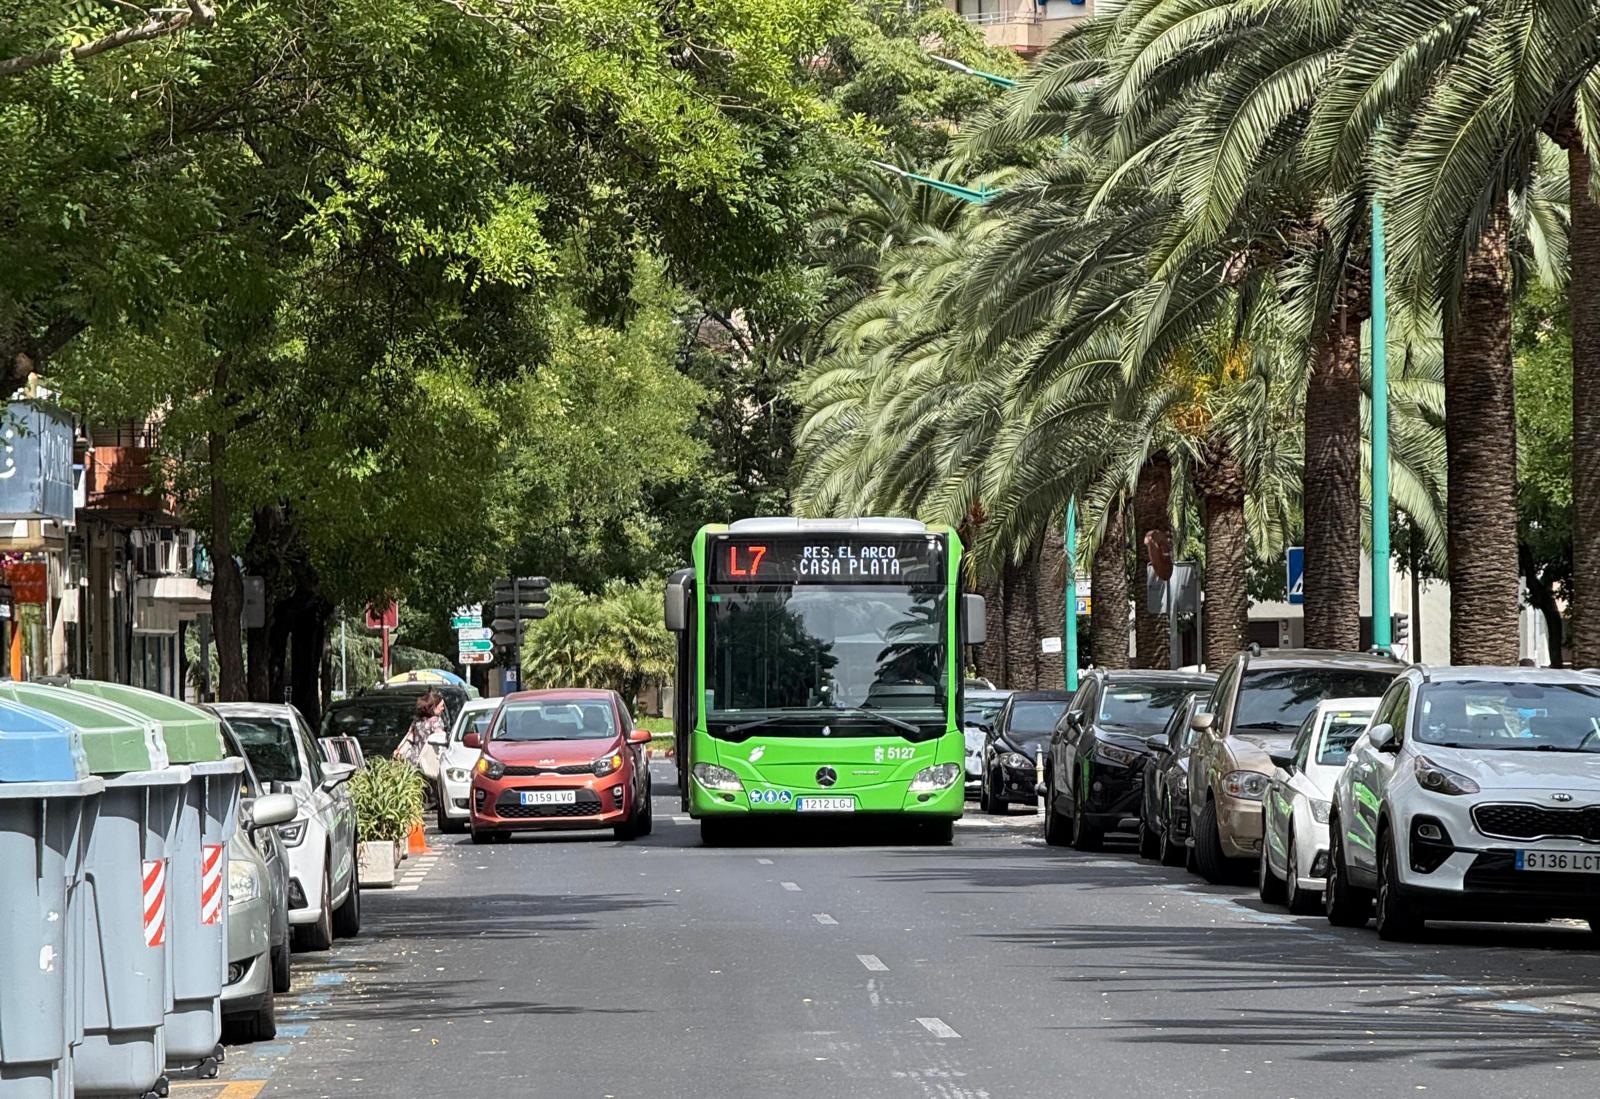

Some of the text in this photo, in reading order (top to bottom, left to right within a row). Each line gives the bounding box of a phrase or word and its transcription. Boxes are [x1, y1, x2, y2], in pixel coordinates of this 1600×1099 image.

[803, 546, 896, 559] RES. EL ARCO
[730, 546, 766, 576] L7
[800, 559, 900, 575] CASA PLATA
[888, 748, 915, 759] 5127
[528, 792, 573, 803] 0159 LVG
[804, 798, 852, 809] 1212 LGJ
[1527, 853, 1568, 869] 6136
